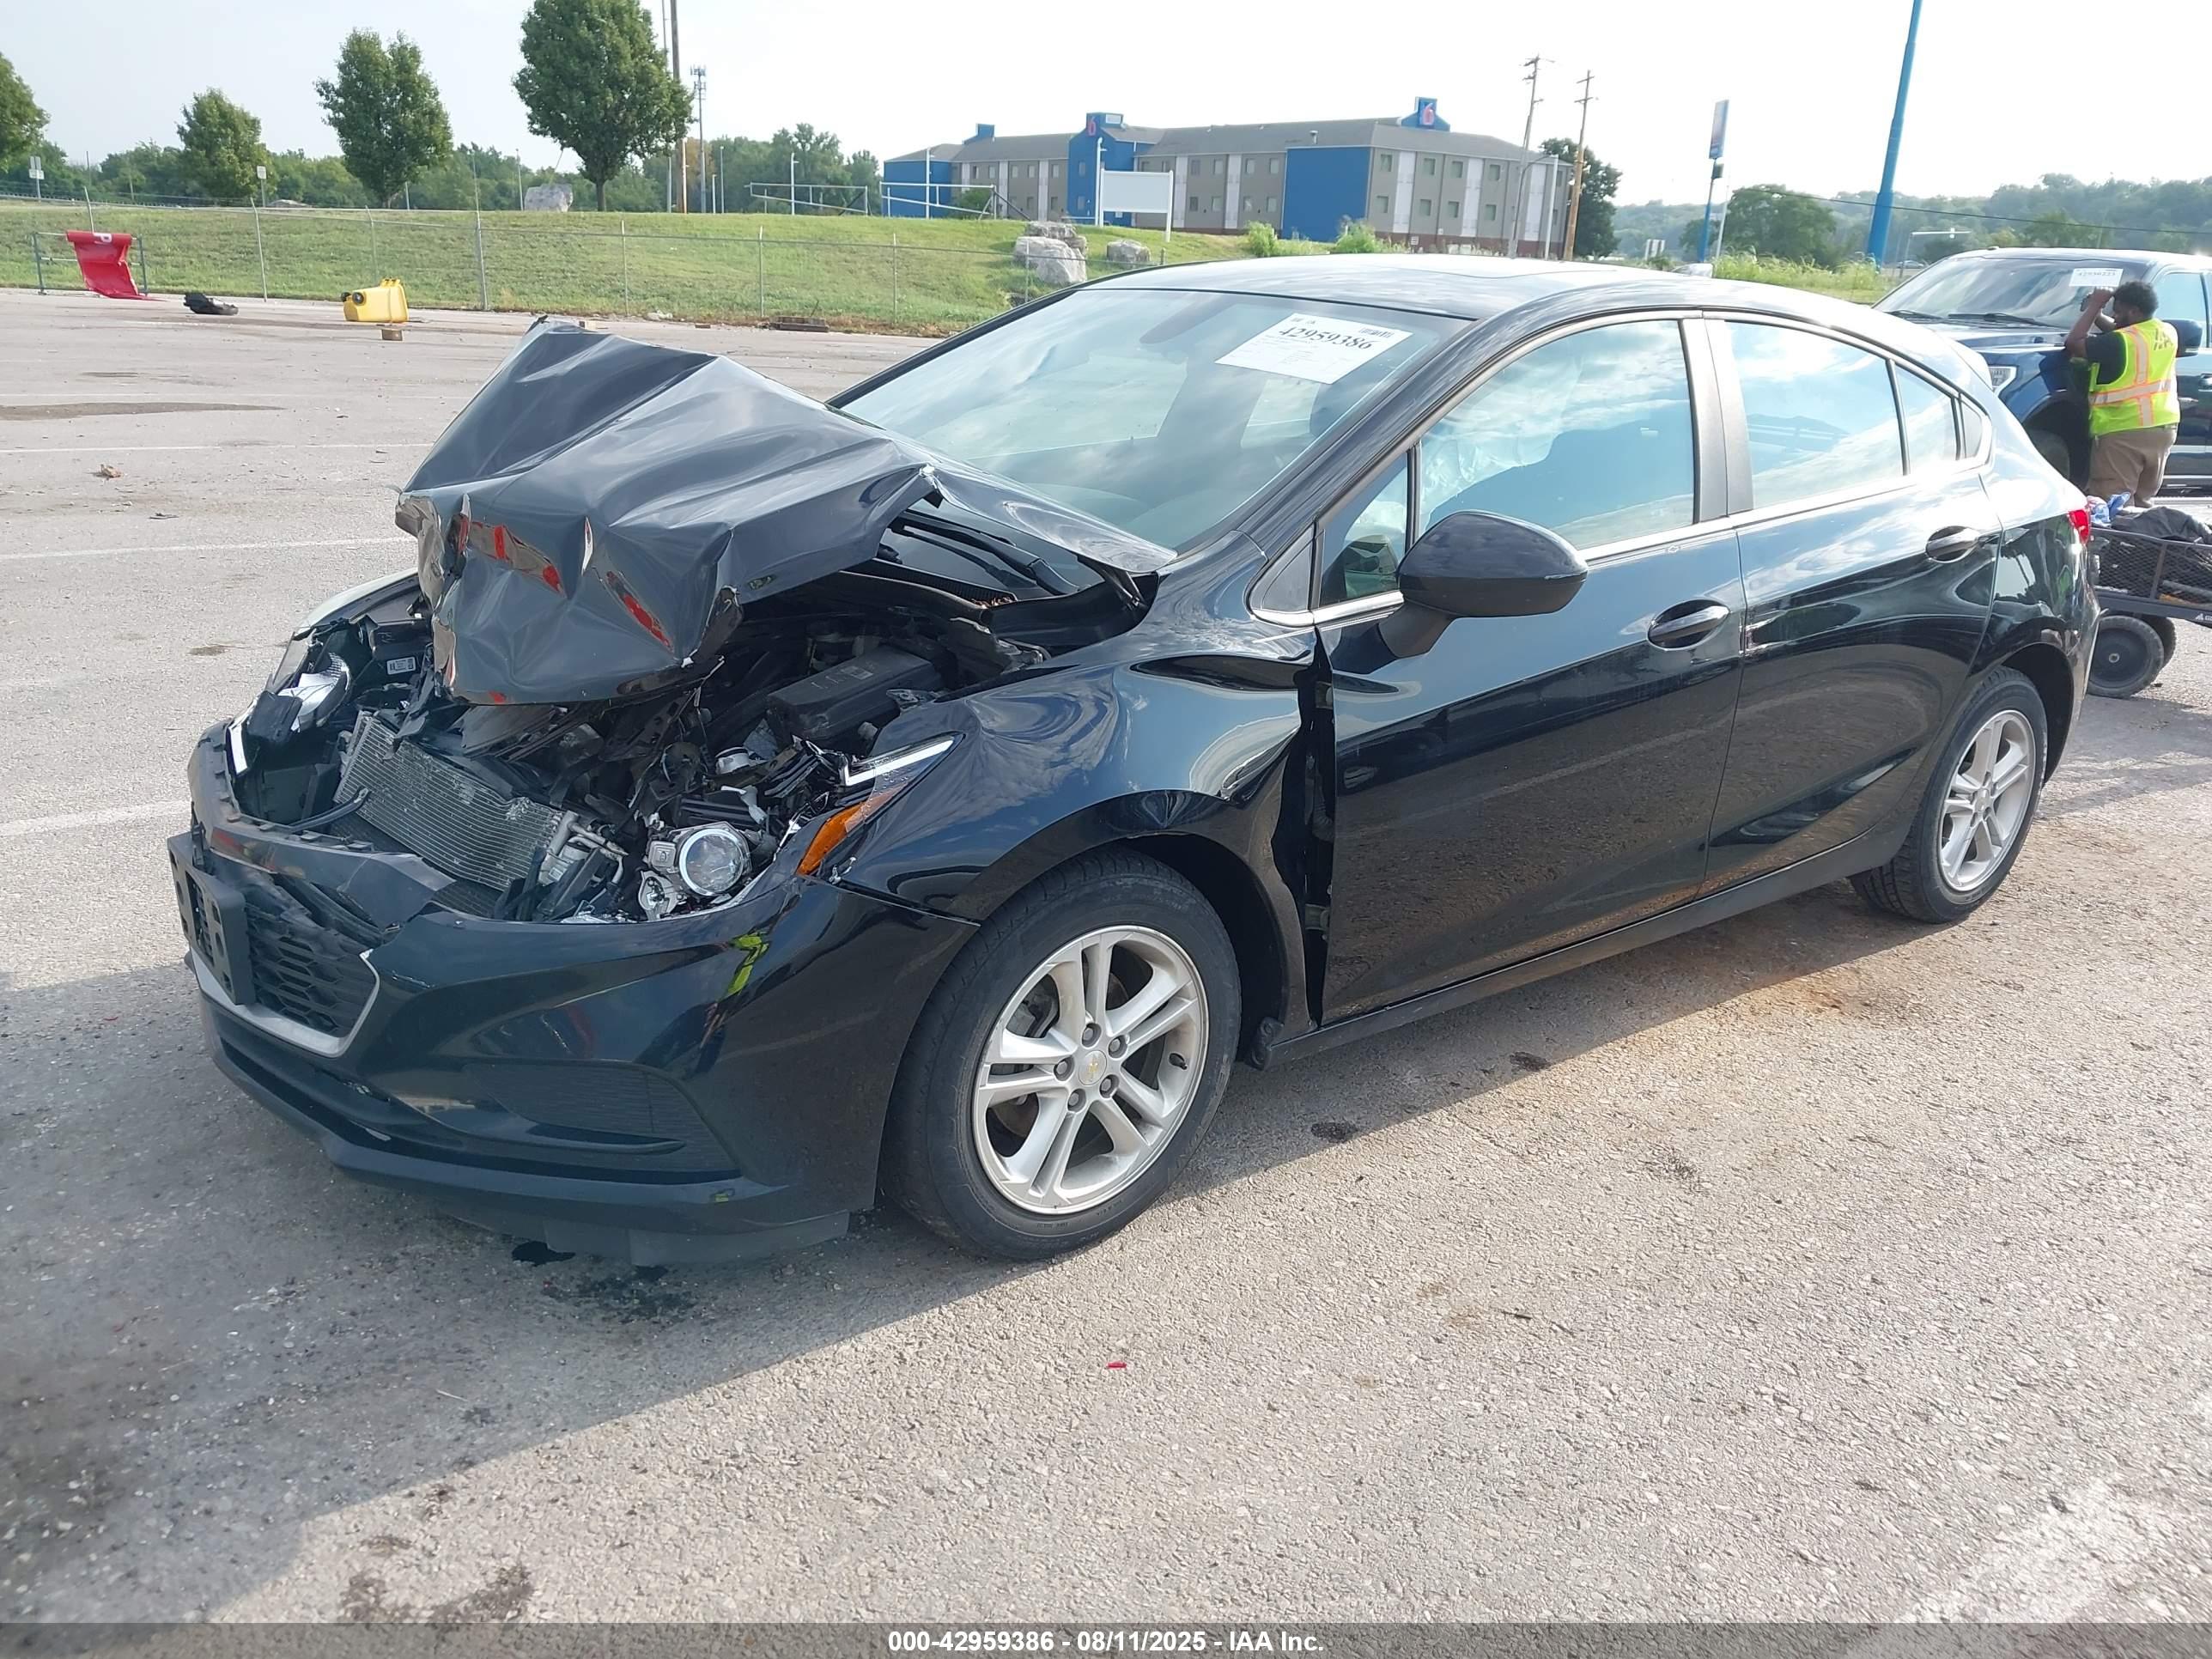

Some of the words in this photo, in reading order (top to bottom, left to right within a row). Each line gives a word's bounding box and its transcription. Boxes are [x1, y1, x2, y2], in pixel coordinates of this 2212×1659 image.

[1422, 101, 1435, 126] 6
[1088, 115, 1097, 137] 6
[1279, 326, 1378, 350] 42959386
